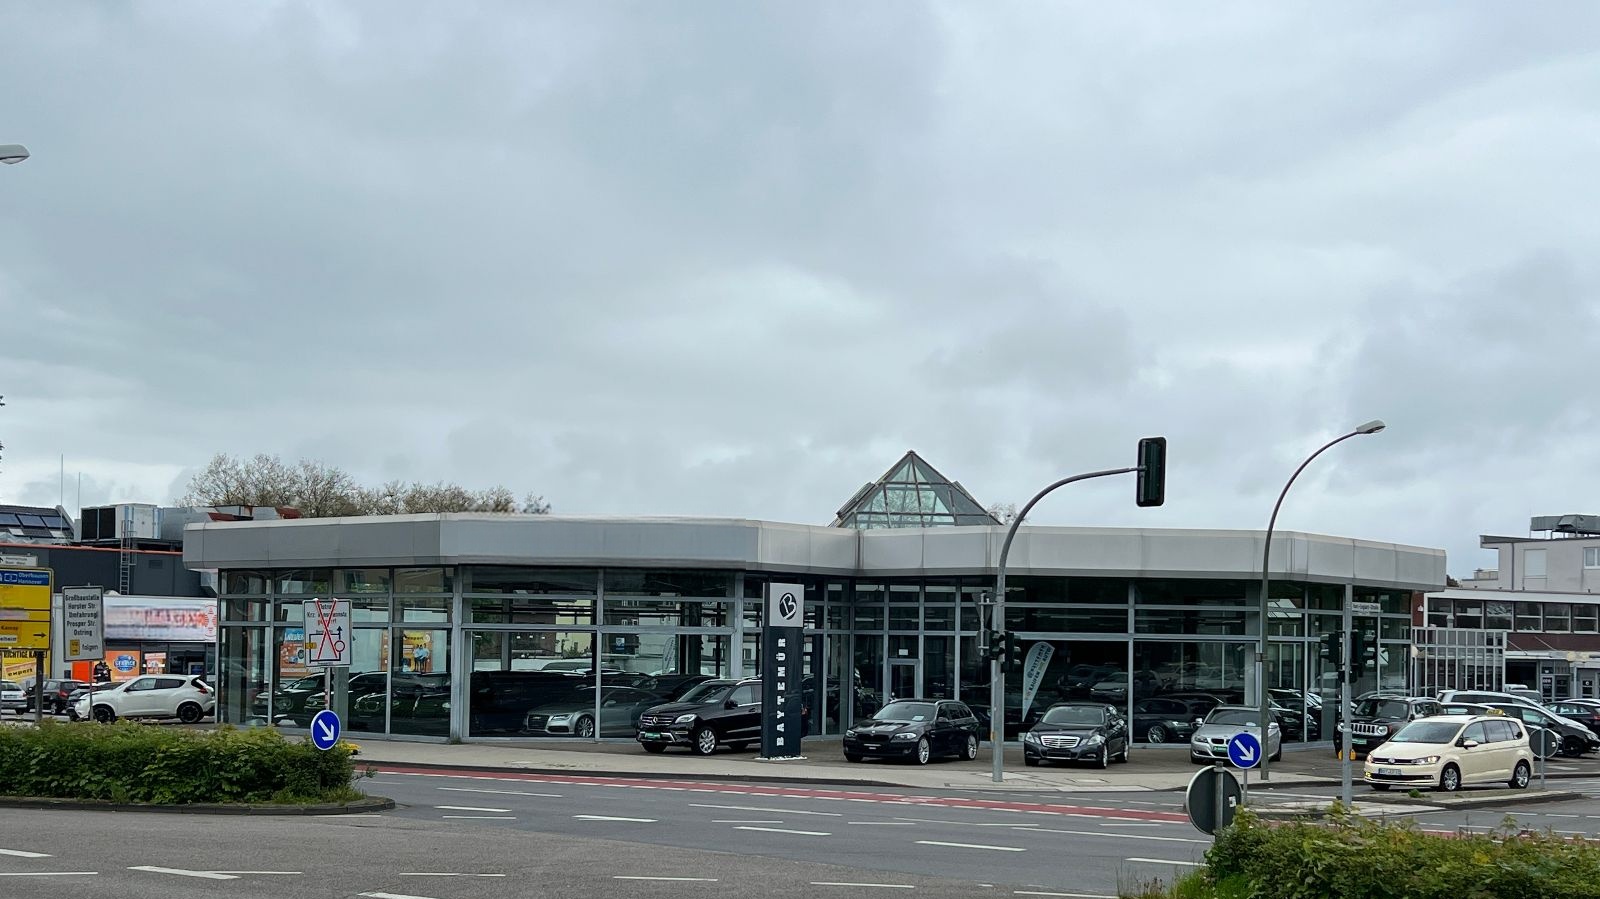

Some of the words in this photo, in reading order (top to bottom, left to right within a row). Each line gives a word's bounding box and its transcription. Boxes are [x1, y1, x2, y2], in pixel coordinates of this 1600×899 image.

[66, 620, 87, 628] Prosper
[73, 629, 93, 637] Ostring
[7, 667, 33, 677] expert
[776, 638, 787, 747] BAYTEMÜR
